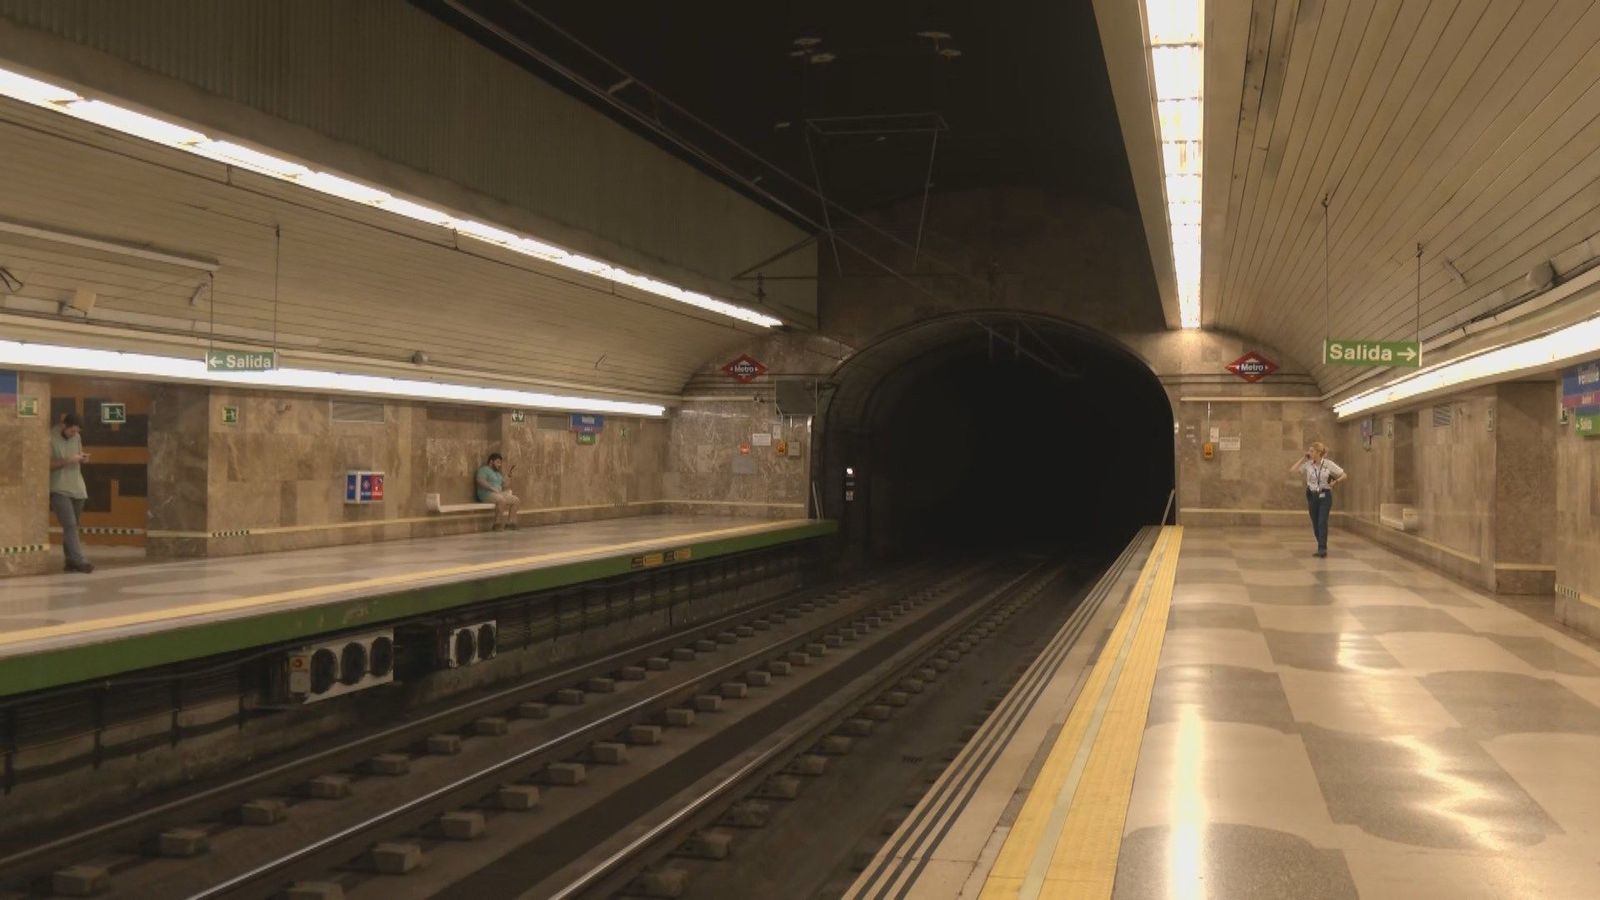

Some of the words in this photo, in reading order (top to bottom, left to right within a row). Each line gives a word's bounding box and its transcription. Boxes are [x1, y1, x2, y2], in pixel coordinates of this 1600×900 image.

[1329, 343, 1392, 361] Salida
[226, 354, 272, 368] Salida
[734, 365, 754, 373] Metro
[1240, 363, 1264, 371] Metro
